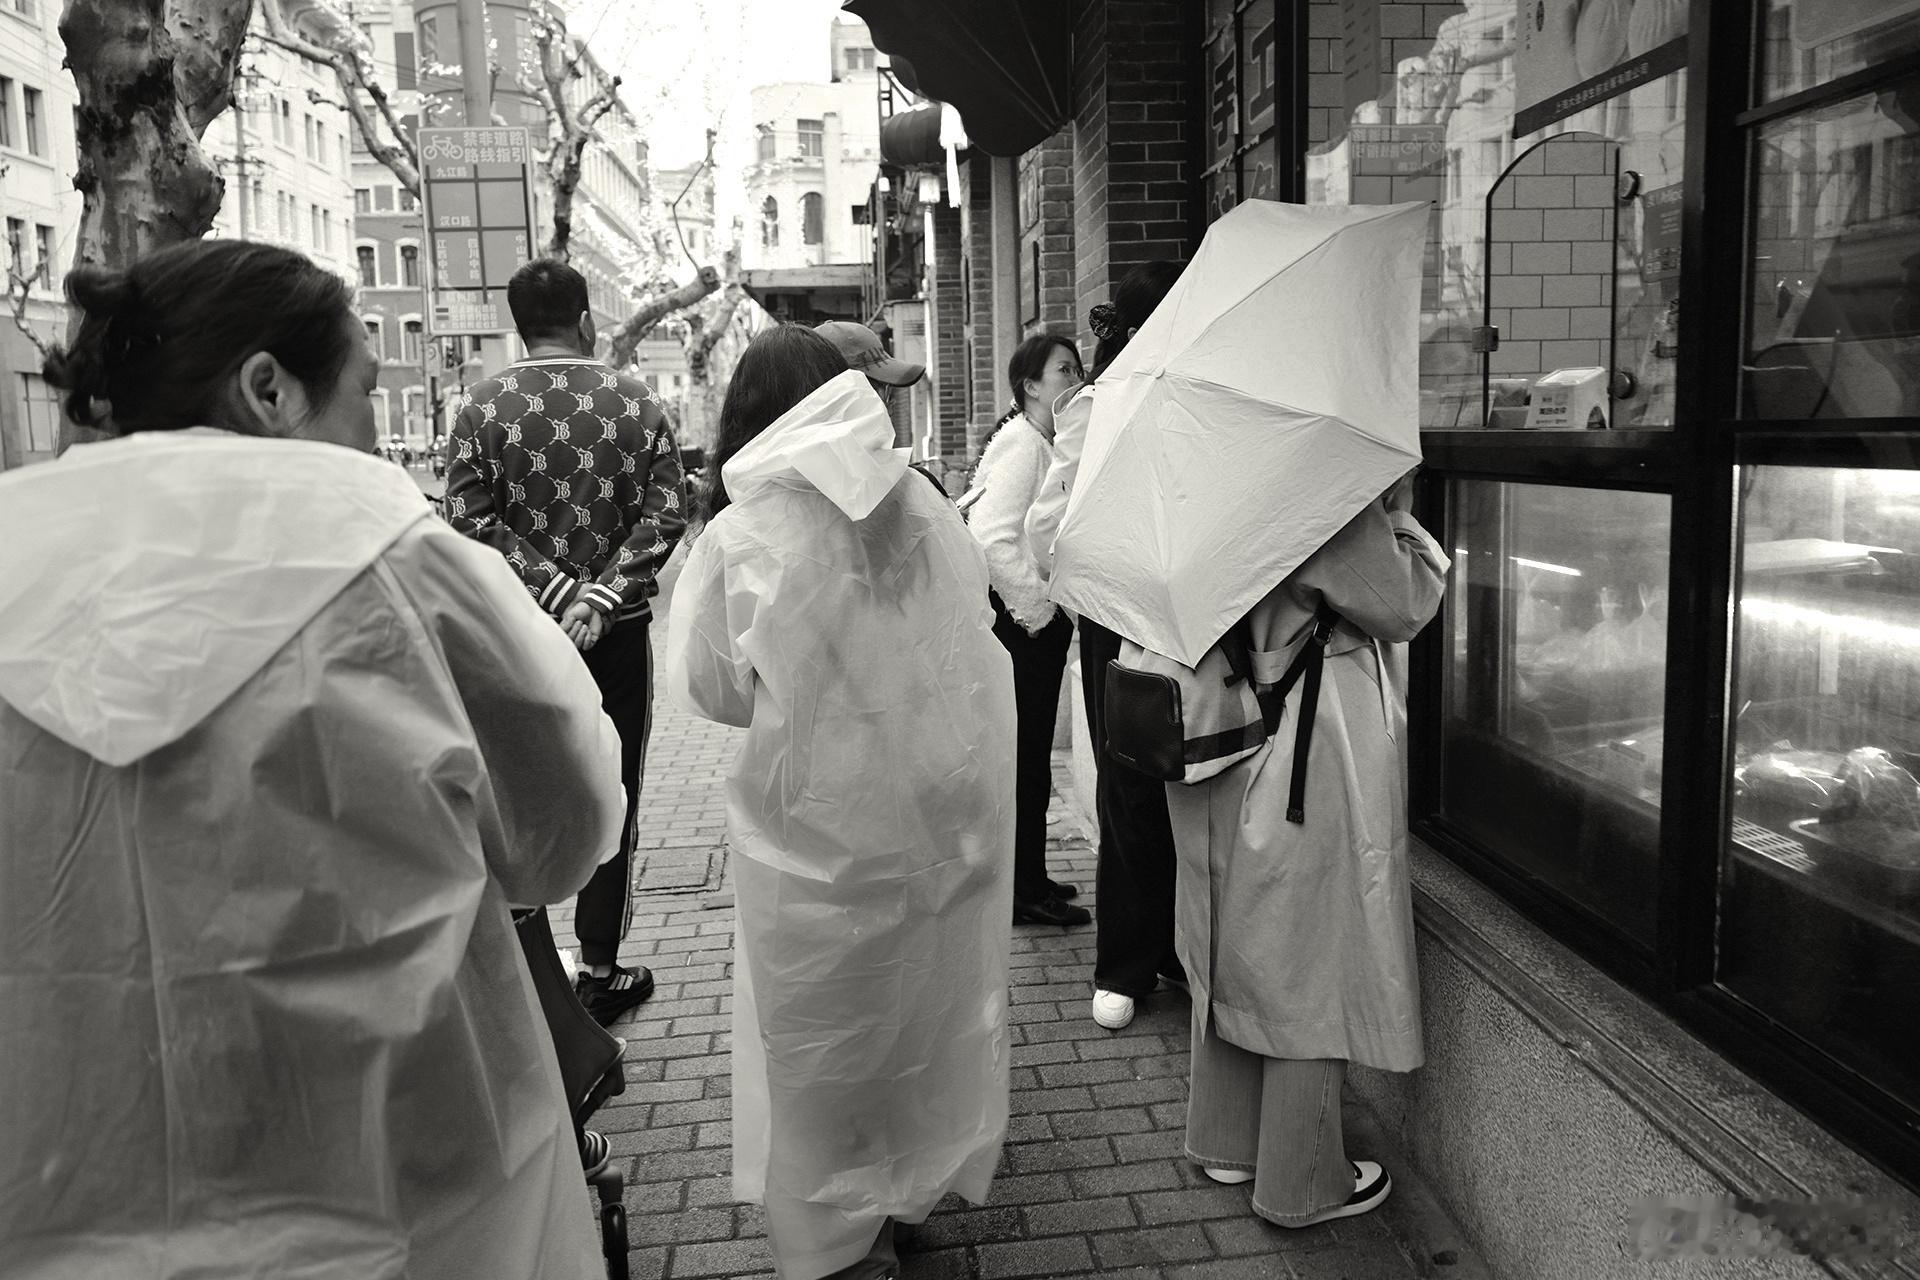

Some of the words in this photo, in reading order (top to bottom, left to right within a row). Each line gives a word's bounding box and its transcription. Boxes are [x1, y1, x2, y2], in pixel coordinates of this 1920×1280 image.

[464, 131, 524, 146] 禁非道路
[464, 147, 526, 163] 路线指引
[436, 167, 468, 178] 九江路
[440, 216, 471, 227] 汉口路
[437, 239, 449, 280] 江西中路
[468, 238, 480, 280] 四川中路
